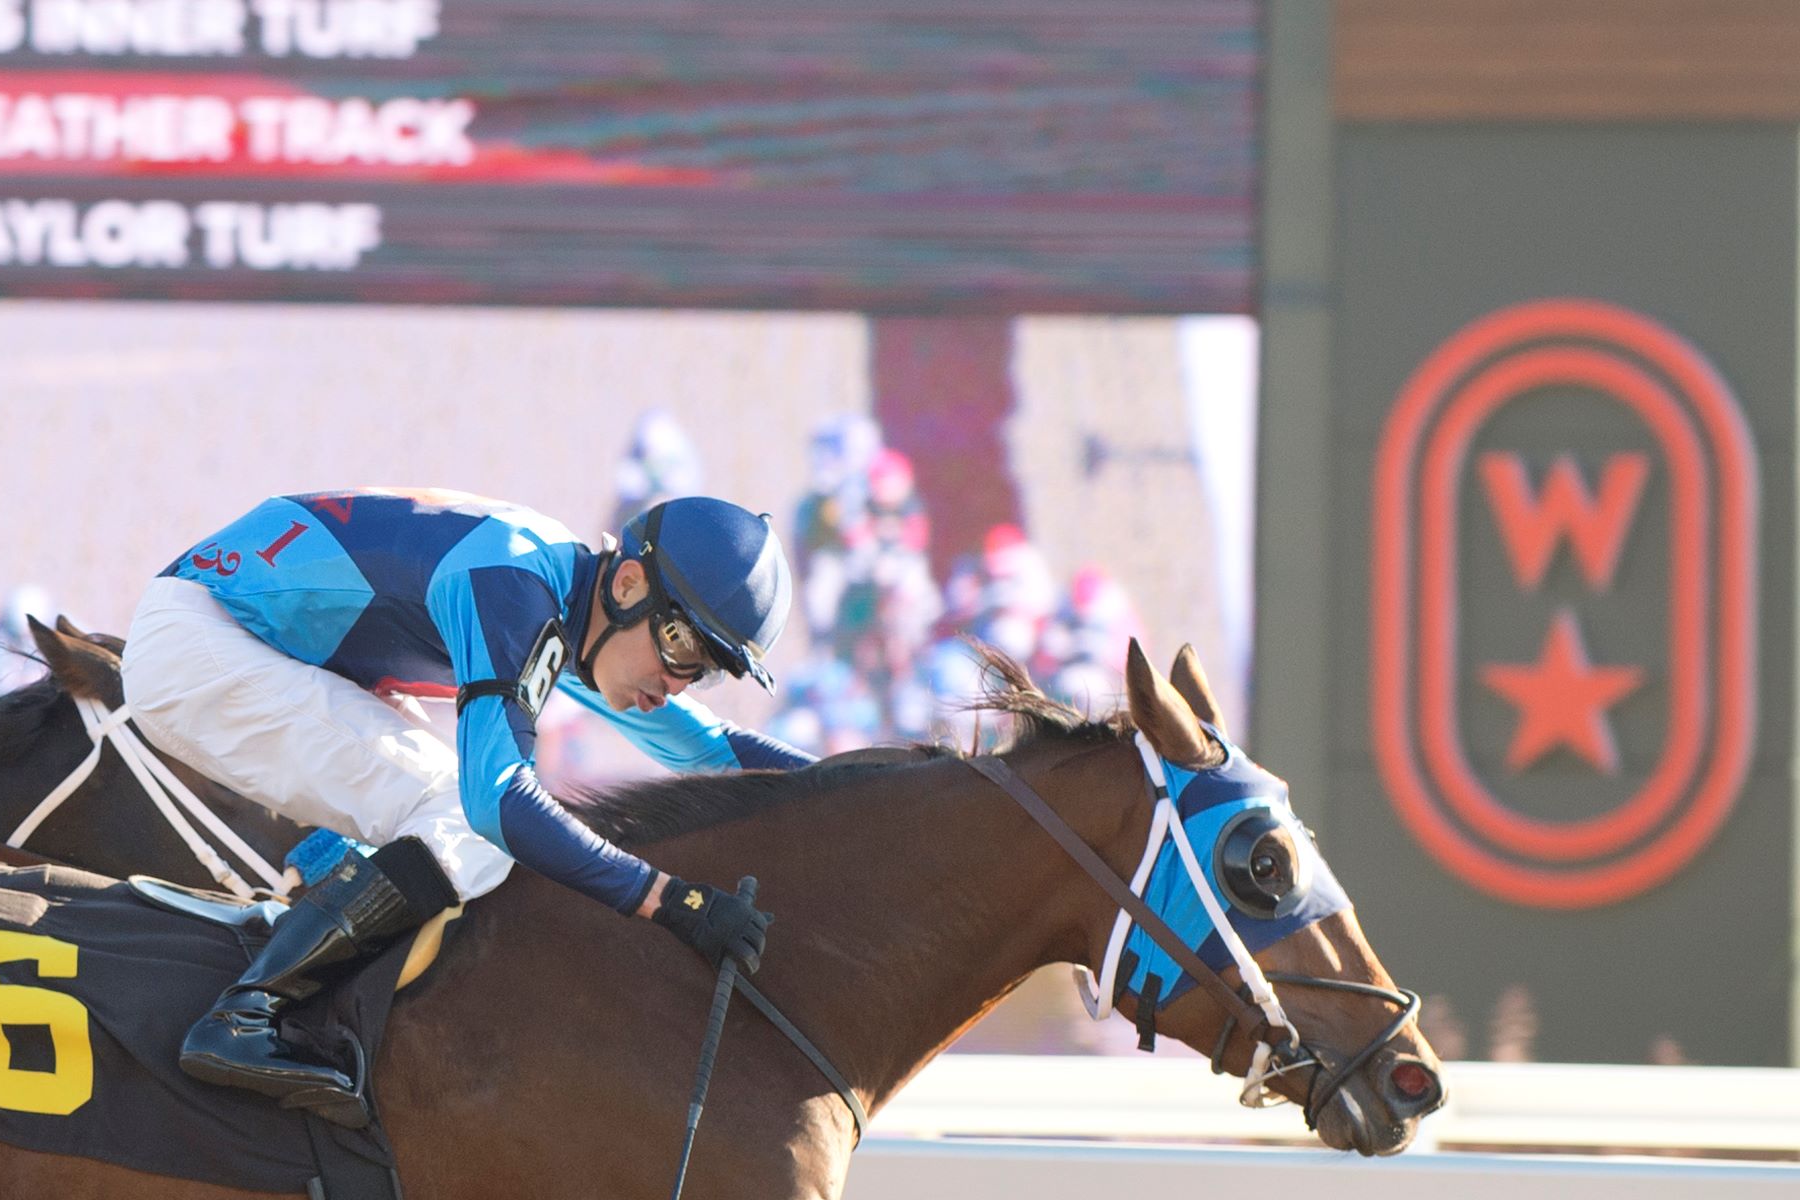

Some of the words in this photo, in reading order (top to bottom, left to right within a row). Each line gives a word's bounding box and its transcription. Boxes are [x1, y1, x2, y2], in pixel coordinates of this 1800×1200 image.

[30, 0, 245, 56] INNER
[249, 0, 442, 59] TURF
[239, 97, 476, 166] TRACK
[193, 201, 382, 270] TURF
[1479, 452, 1648, 592] W
[527, 635, 565, 716] 6
